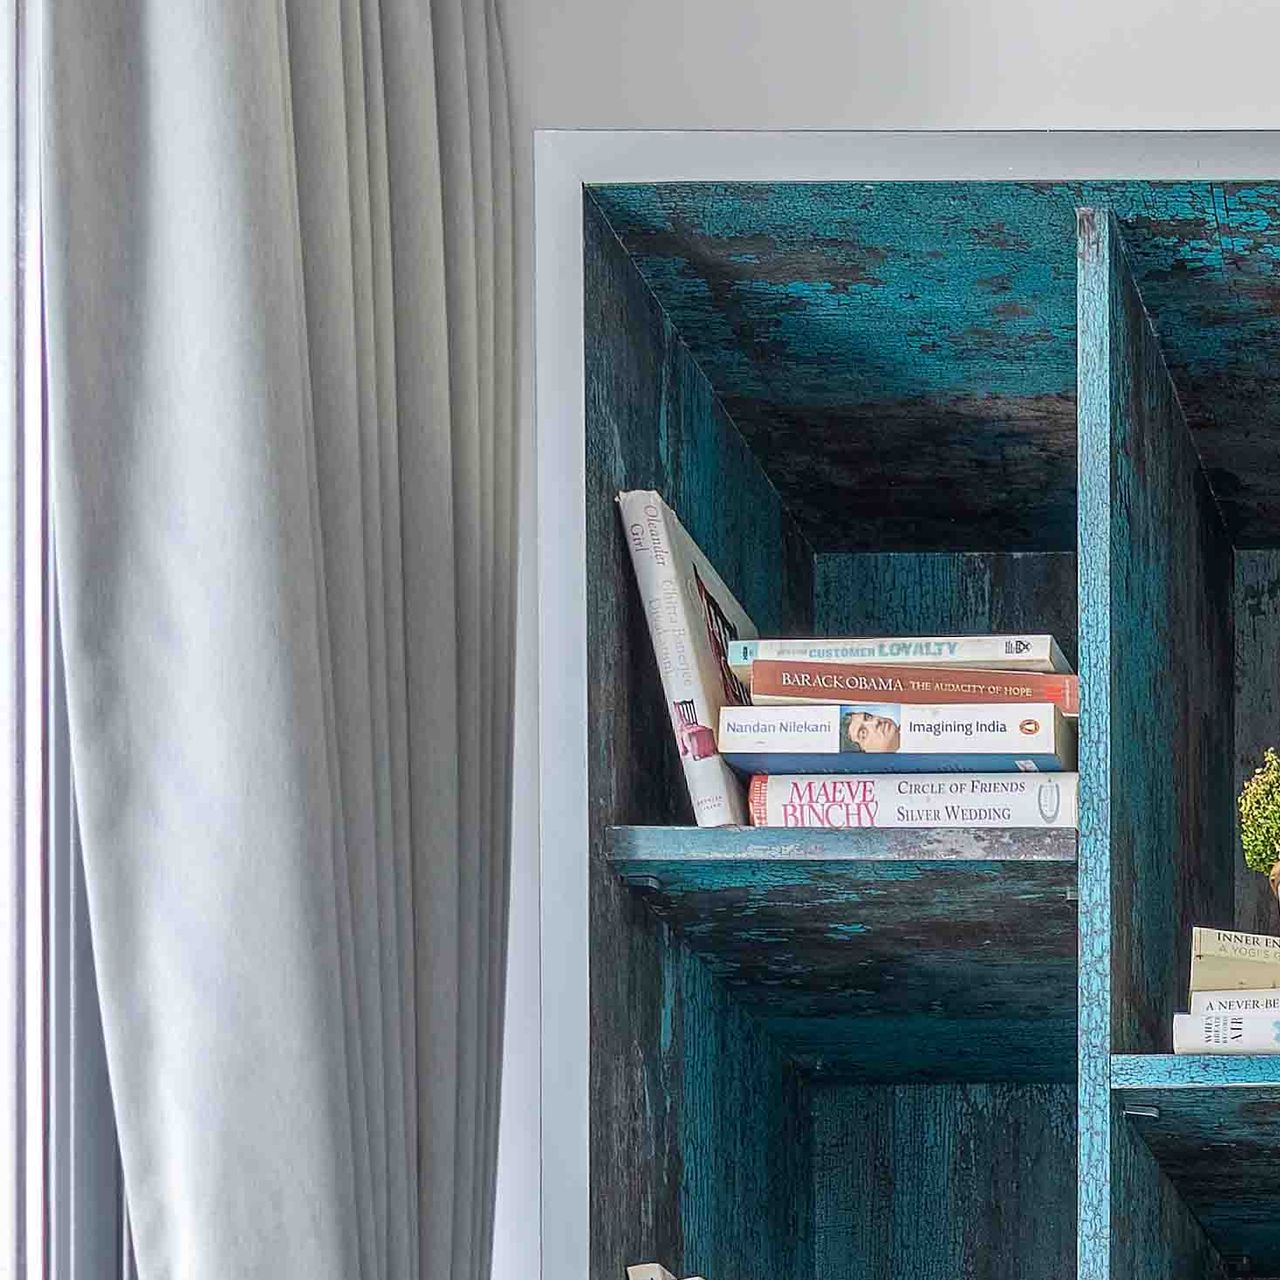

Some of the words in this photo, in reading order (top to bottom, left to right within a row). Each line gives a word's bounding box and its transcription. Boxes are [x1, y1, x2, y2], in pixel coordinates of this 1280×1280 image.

[629, 523, 648, 553] Girl
[643, 505, 670, 567] Oleander
[809, 647, 876, 658] CUSTOMER
[782, 673, 845, 689] BARACK
[845, 676, 904, 692] OBAMA
[910, 681, 931, 691] THE
[934, 682, 985, 692] AUDACITY
[1004, 686, 1032, 697] HOPE
[726, 721, 776, 733] Nandan
[779, 721, 831, 733] Nilekani
[909, 721, 972, 734] Imagining
[976, 721, 1007, 734] India
[789, 781, 876, 803] MAEVE
[898, 781, 945, 795] CIRCLE
[949, 782, 967, 794] OF
[970, 780, 1026, 793] FRIENDS
[782, 802, 878, 826] BINCHY
[897, 806, 941, 822] SILVER
[945, 806, 1011, 821] WEDDING
[1217, 932, 1262, 948] INNER
